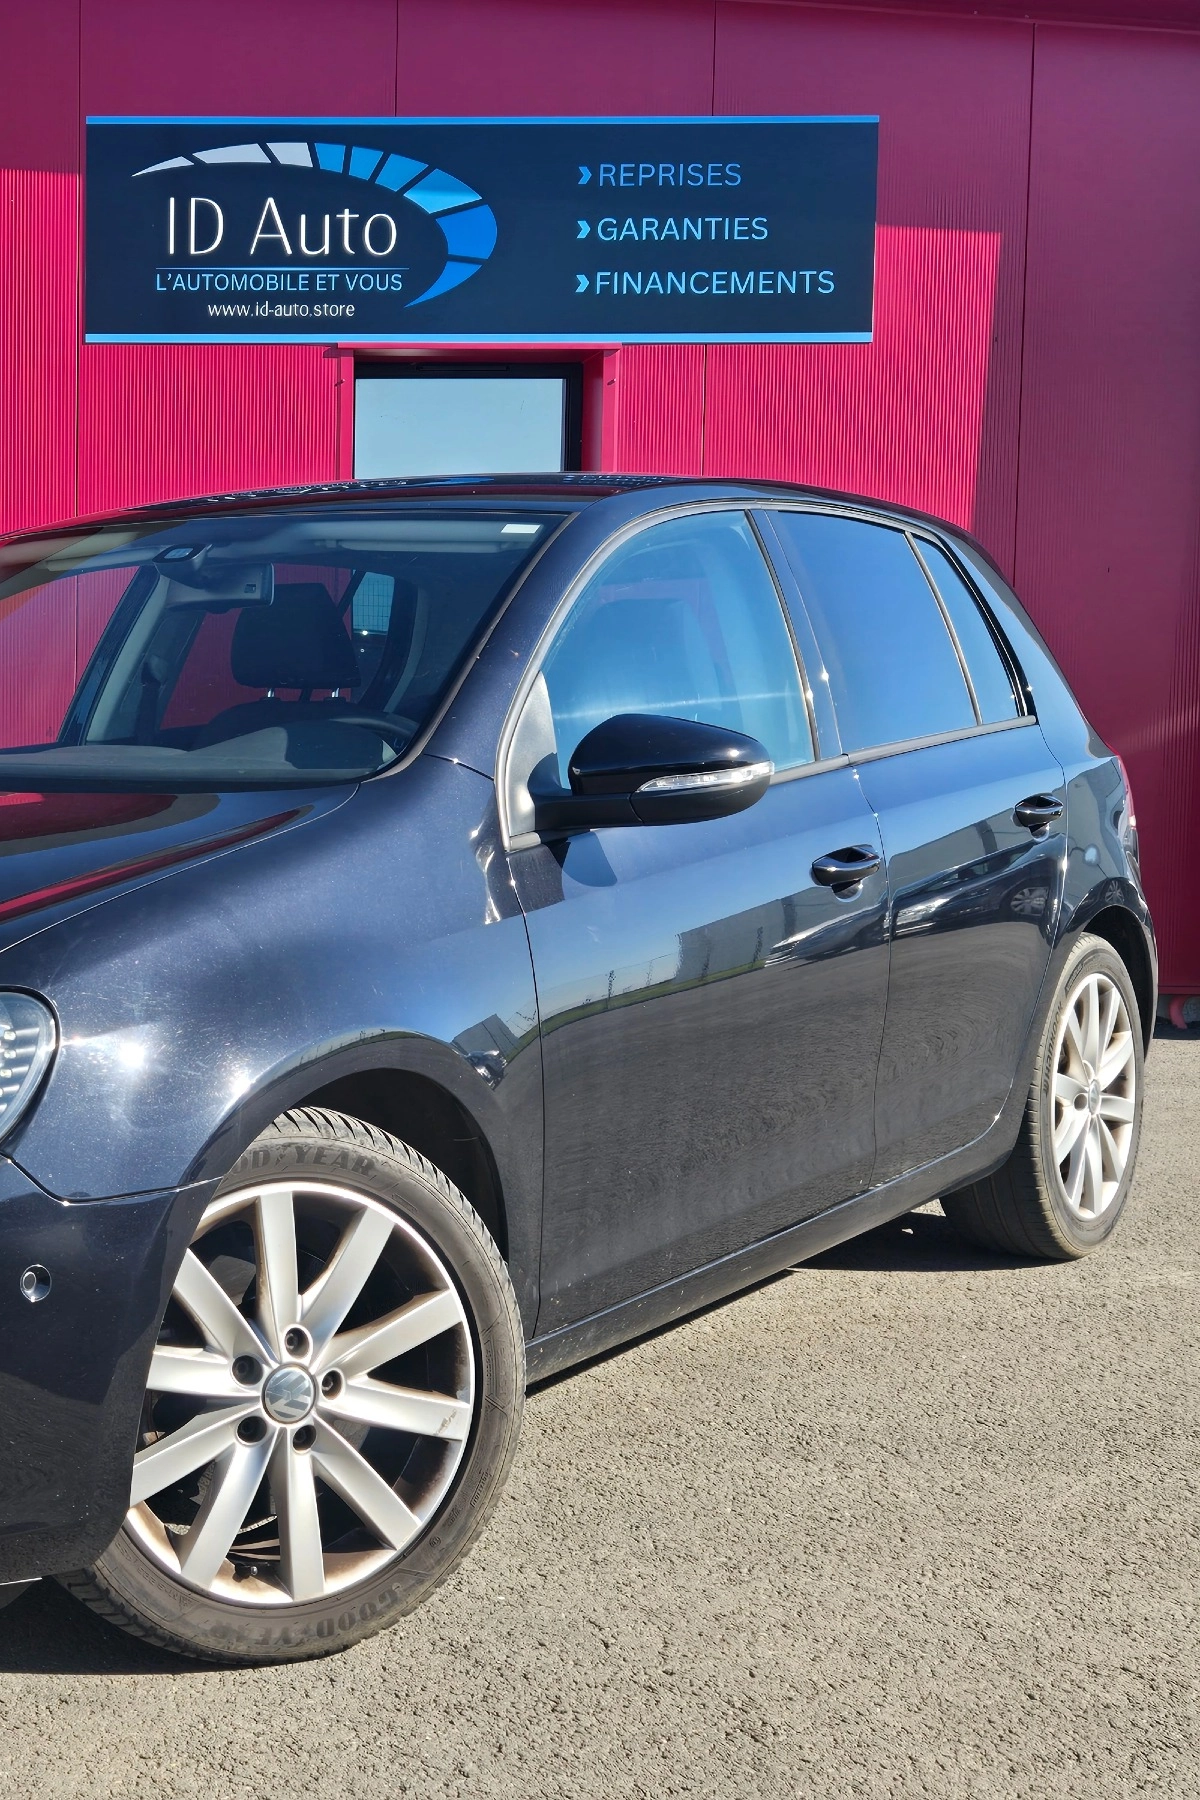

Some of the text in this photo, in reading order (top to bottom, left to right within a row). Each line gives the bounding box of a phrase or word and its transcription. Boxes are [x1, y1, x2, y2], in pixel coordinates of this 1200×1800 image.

[599, 163, 742, 187] REPRISES
[169, 196, 398, 257] ID Auto
[597, 217, 768, 241] GARANTIES
[156, 273, 403, 292] L'AUTOMOBILE ET VOUS
[596, 270, 835, 295] FINANCEMENTS
[207, 300, 355, 318] www.id-auto.store
